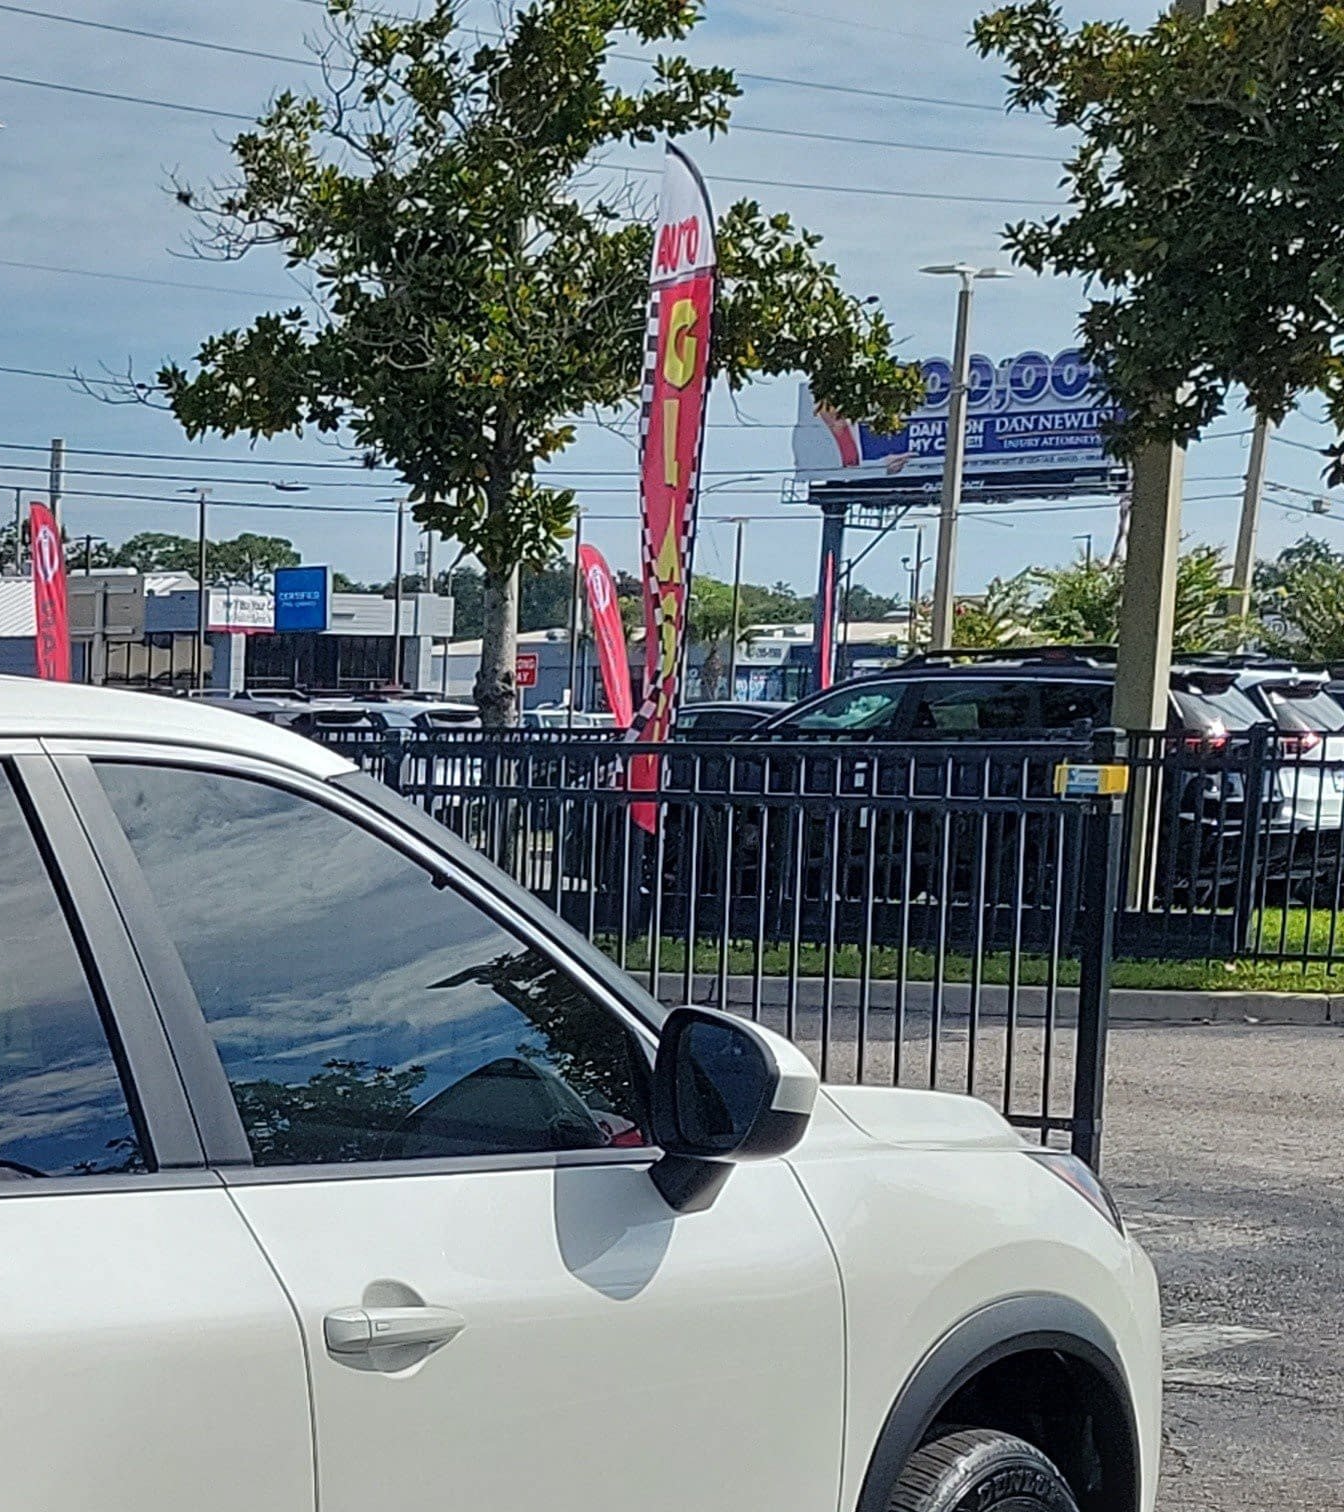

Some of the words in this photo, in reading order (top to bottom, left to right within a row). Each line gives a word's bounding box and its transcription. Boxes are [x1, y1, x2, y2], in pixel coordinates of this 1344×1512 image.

[657, 221, 699, 274] AUTO
[908, 423, 944, 438] DAN
[995, 416, 1035, 434] DAN
[908, 437, 931, 451] MY
